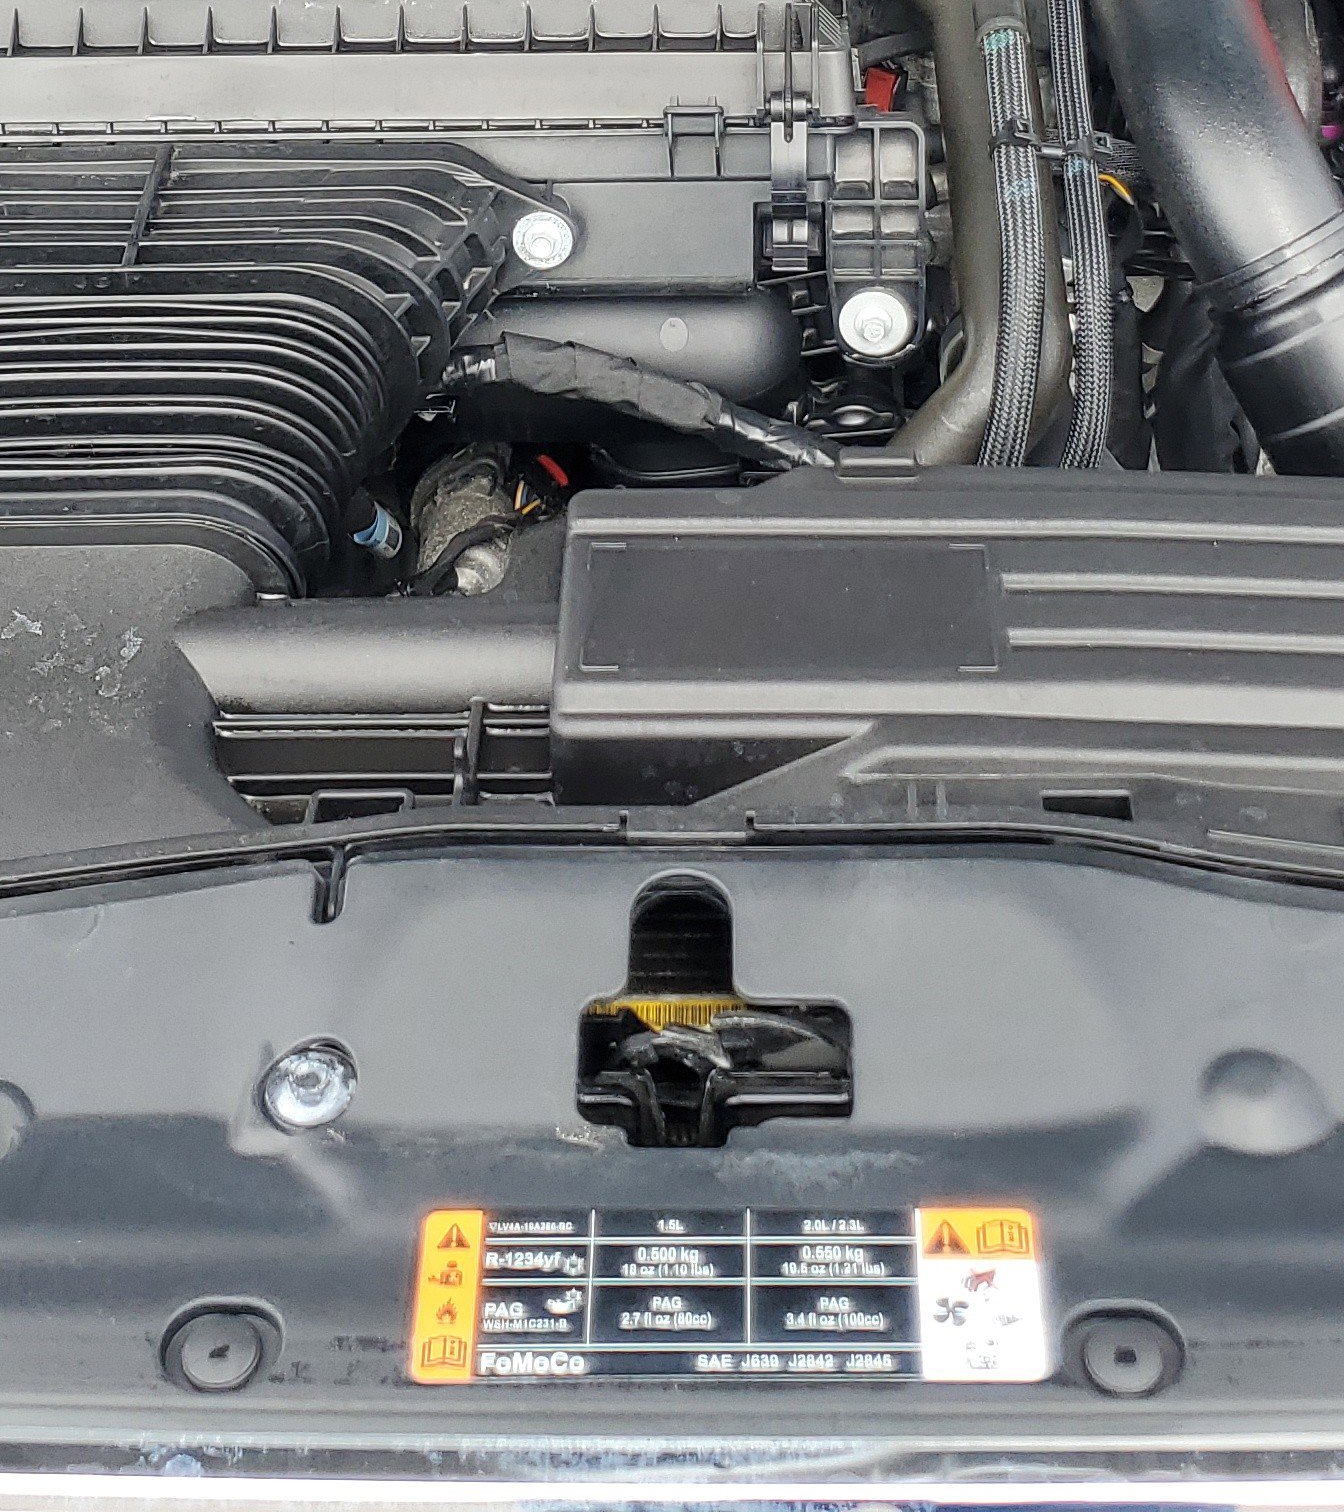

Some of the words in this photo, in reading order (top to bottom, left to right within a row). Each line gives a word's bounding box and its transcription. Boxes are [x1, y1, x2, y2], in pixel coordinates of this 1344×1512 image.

[656, 1219, 684, 1232] 1.5L
[485, 1251, 562, 1272] R-1234yf
[637, 1246, 676, 1262] 0.500
[680, 1246, 699, 1264] kg
[844, 1244, 864, 1263] kg
[640, 1265, 655, 1276] oz
[810, 1264, 826, 1276] oz
[484, 1301, 525, 1318] PAG
[652, 1295, 683, 1310] PAG
[819, 1296, 851, 1310] PAG
[621, 1311, 641, 1326] 2.7
[655, 1314, 671, 1326] oz
[673, 1310, 712, 1330] (80cc)
[786, 1312, 805, 1326] 3.4
[819, 1314, 835, 1326] oz
[837, 1311, 884, 1329] (100cc)
[479, 1350, 586, 1375] FoMoCo
[697, 1353, 732, 1368] SAE
